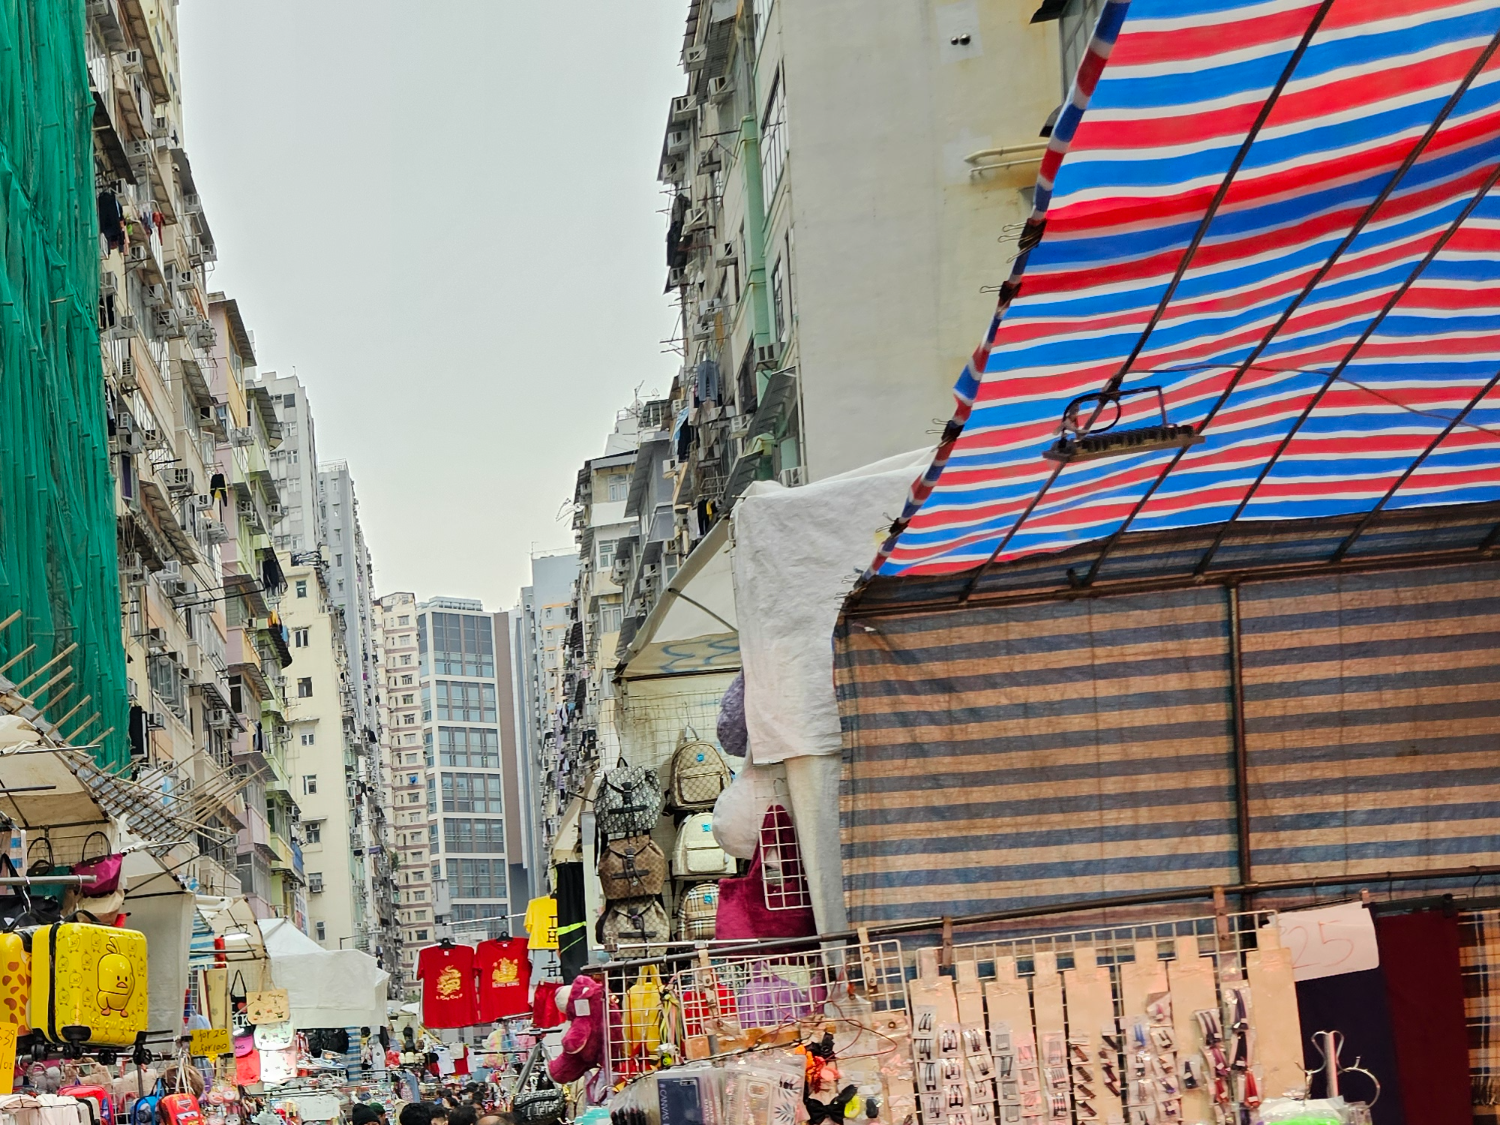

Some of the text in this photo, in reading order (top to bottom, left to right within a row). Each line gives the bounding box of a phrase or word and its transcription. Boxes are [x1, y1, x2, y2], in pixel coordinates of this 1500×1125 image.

[1280, 919, 1354, 969] 25
[199, 1030, 227, 1042] for 20
[192, 1047, 198, 1055] 6
[201, 1044, 211, 1053] for
[660, 1090, 670, 1121] CANVAS
